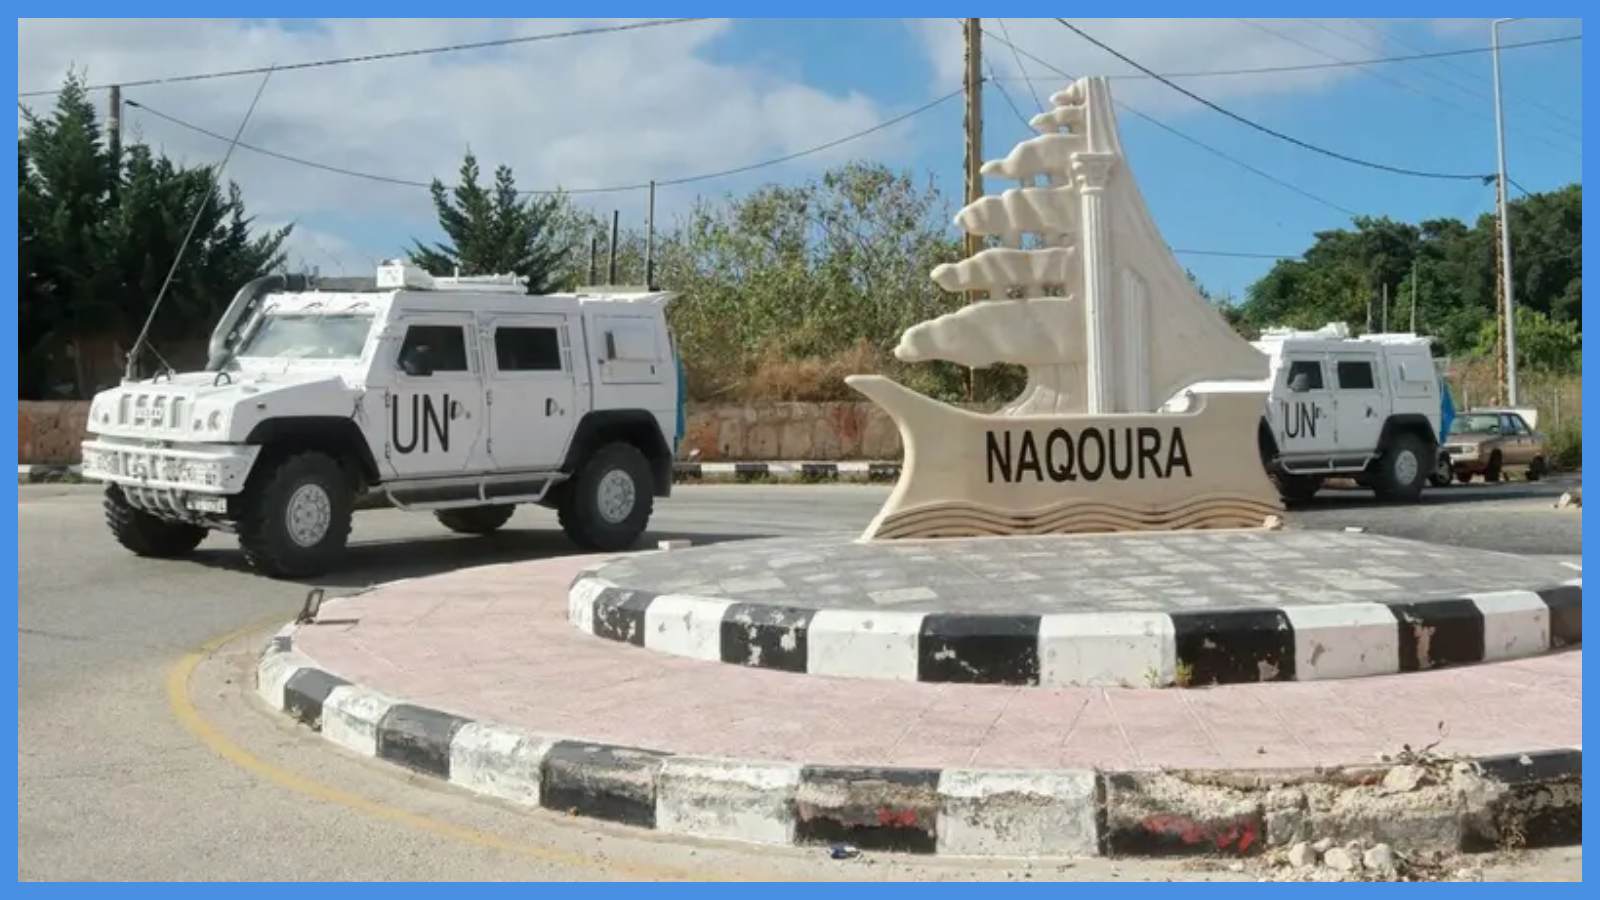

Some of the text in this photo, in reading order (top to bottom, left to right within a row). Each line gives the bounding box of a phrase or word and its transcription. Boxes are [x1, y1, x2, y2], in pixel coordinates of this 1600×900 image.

[392, 394, 449, 453] UN
[1285, 402, 1315, 438] UN
[986, 427, 1192, 483] NAQOURA
